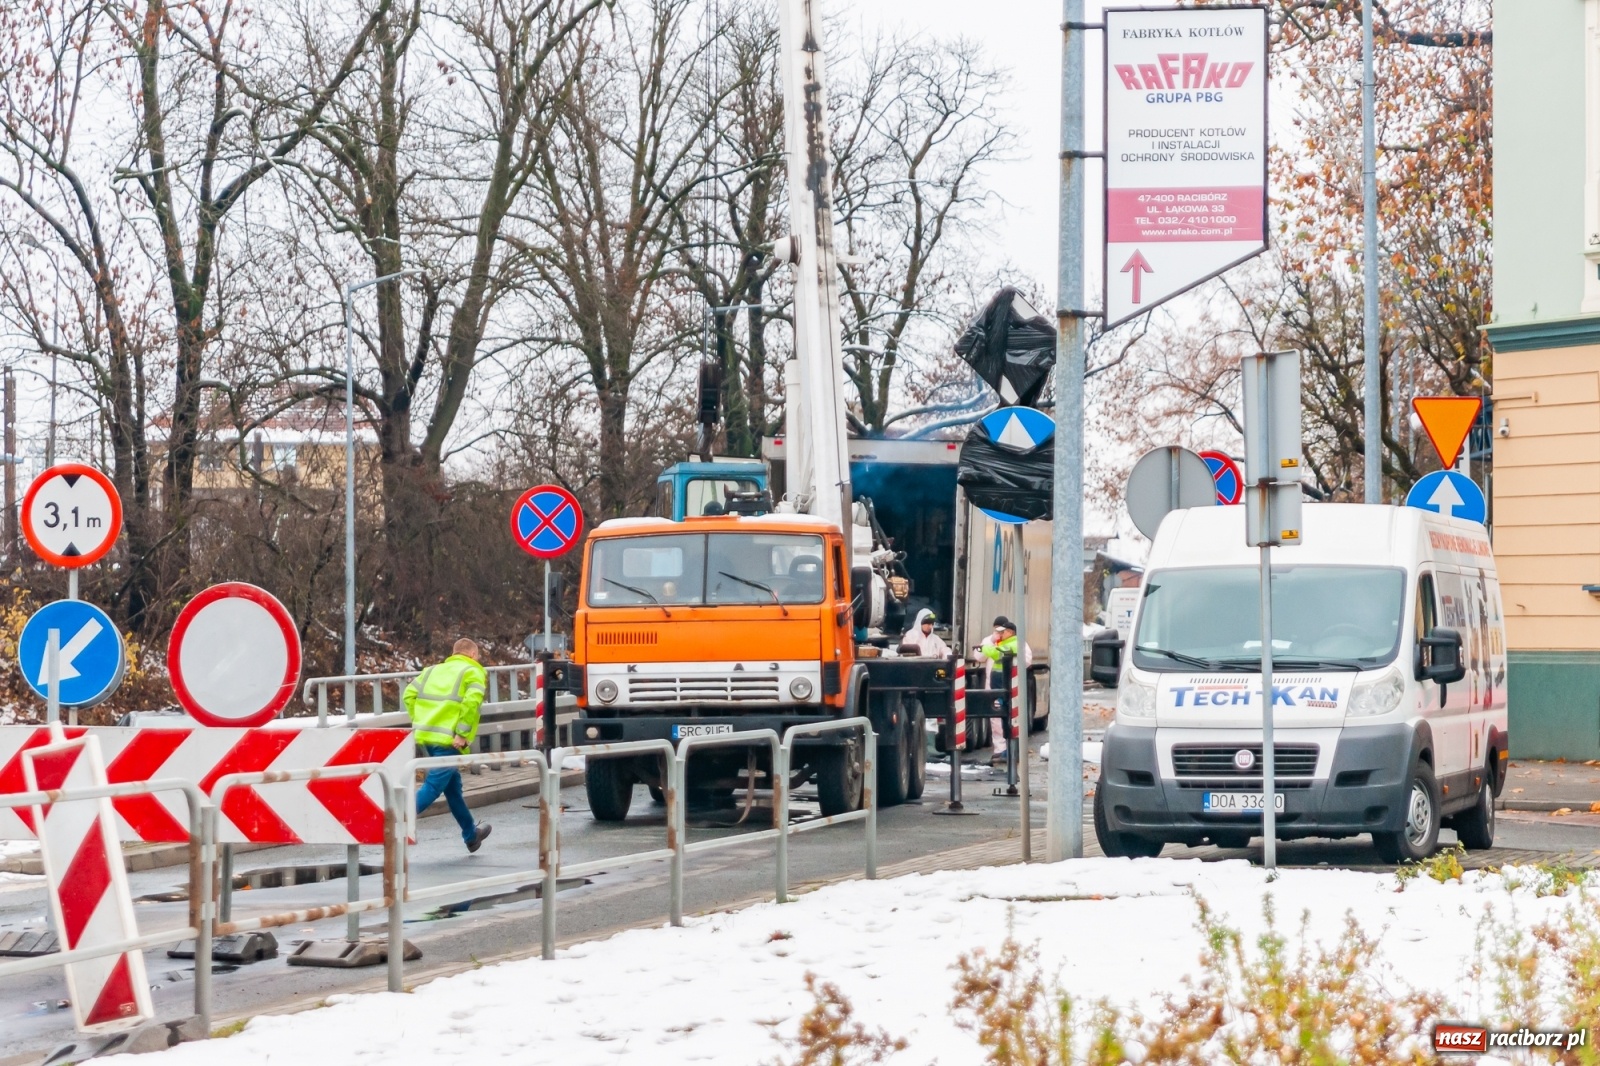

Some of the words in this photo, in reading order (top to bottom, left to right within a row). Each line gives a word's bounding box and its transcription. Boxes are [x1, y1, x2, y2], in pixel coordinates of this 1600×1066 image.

[1122, 28, 1182, 39] FABRYKA
[1188, 24, 1245, 38] KOTŁÓW
[1145, 93, 1192, 104] GRUPA
[1196, 92, 1224, 103] PBG
[1128, 128, 1195, 138] PRODUCENT
[1199, 126, 1247, 137] KOTŁÓW
[1158, 140, 1220, 150] INSTALACJI
[1120, 153, 1175, 163] OCHRONY
[1180, 151, 1255, 162] ŚRODOWISKA
[1137, 194, 1175, 203] 47-400
[1177, 192, 1228, 202] RACIBÓRZ
[1146, 205, 1162, 214] UL.
[1165, 205, 1209, 215] ŁĄKOWA
[1211, 204, 1225, 213] 33
[1134, 216, 1155, 225] TEL.
[1141, 227, 1233, 236] www.rafako.com.pl
[43, 501, 79, 532] 3,1
[86, 516, 102, 528] m
[679, 726, 702, 738] SRC
[1211, 794, 1236, 808] DOA
[1241, 794, 1283, 809] 3360
